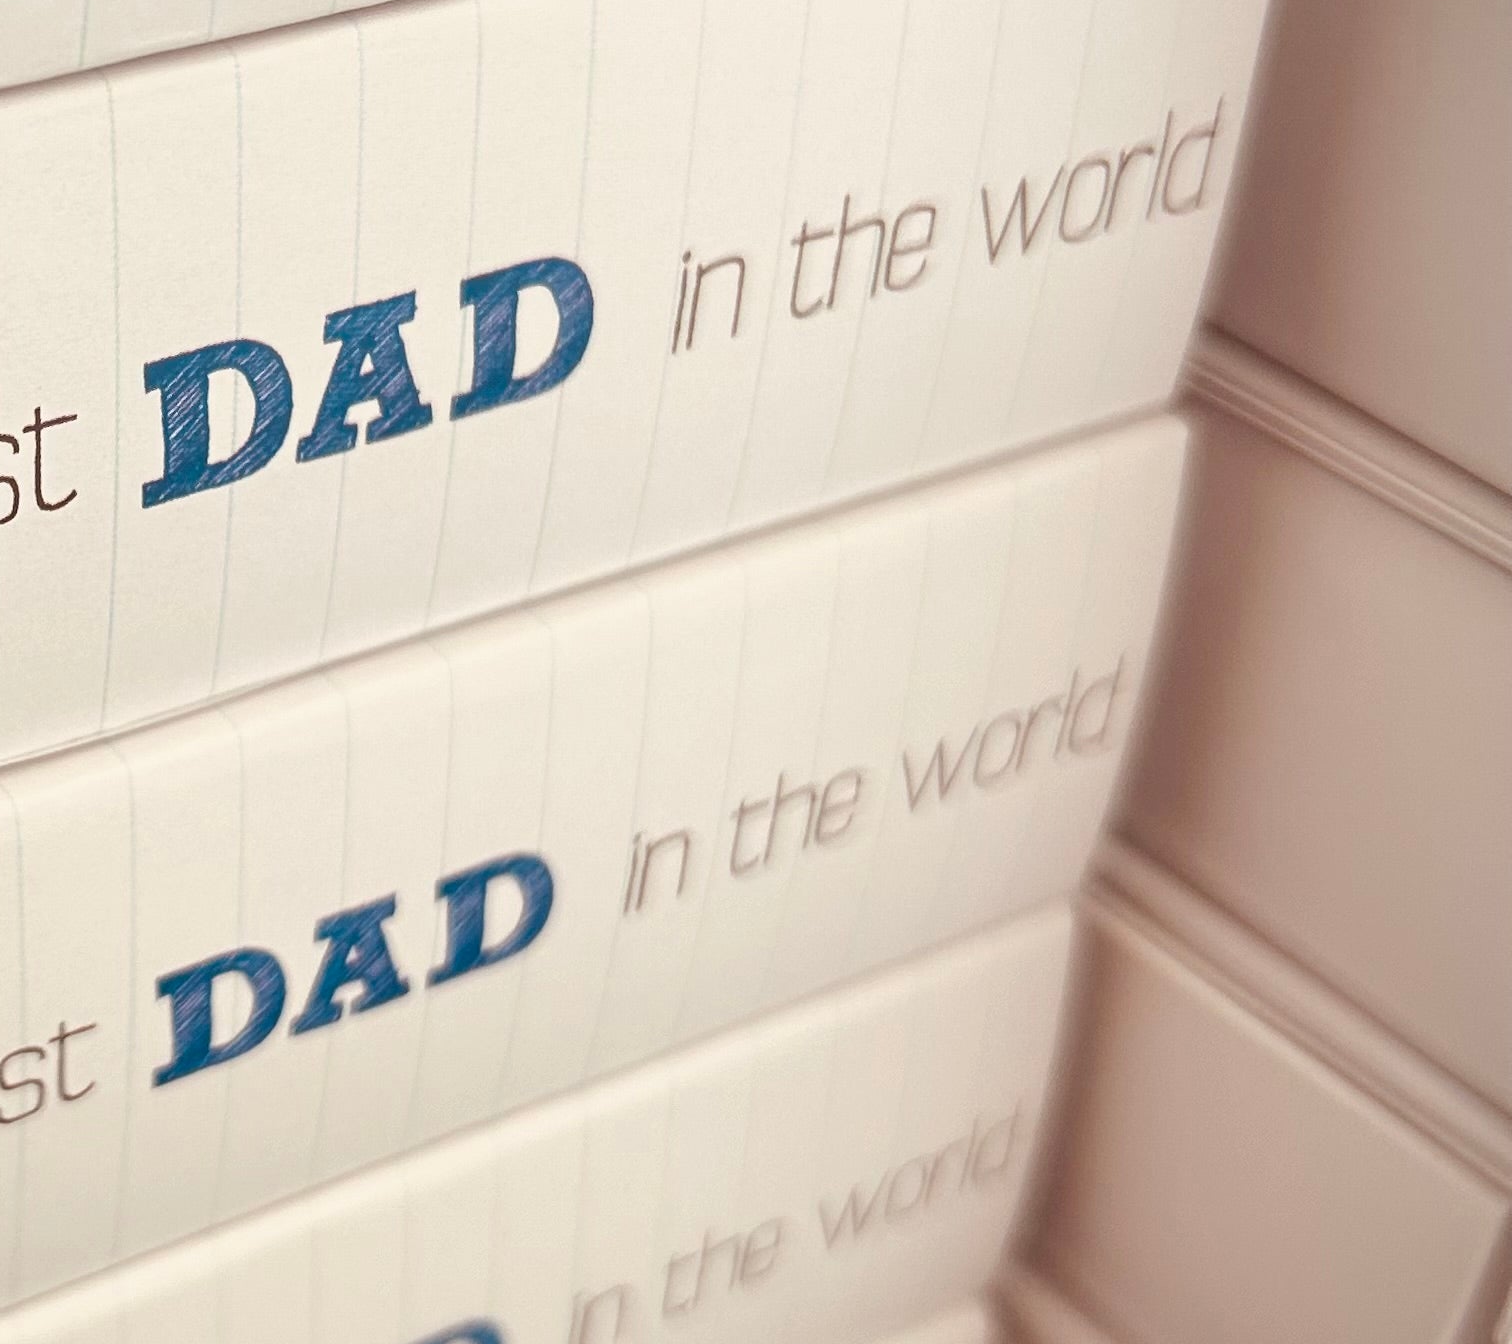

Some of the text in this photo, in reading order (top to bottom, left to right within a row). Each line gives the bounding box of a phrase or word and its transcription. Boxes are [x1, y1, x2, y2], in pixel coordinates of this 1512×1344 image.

[141, 257, 595, 509] DAD
[671, 250, 746, 357] in
[790, 194, 936, 322] the
[980, 95, 1225, 266] world
[152, 853, 556, 1089] DAD
[623, 829, 692, 917] in
[728, 770, 863, 879] the
[900, 654, 1126, 813] world
[662, 1216, 785, 1320] the
[818, 1099, 1025, 1253] world
